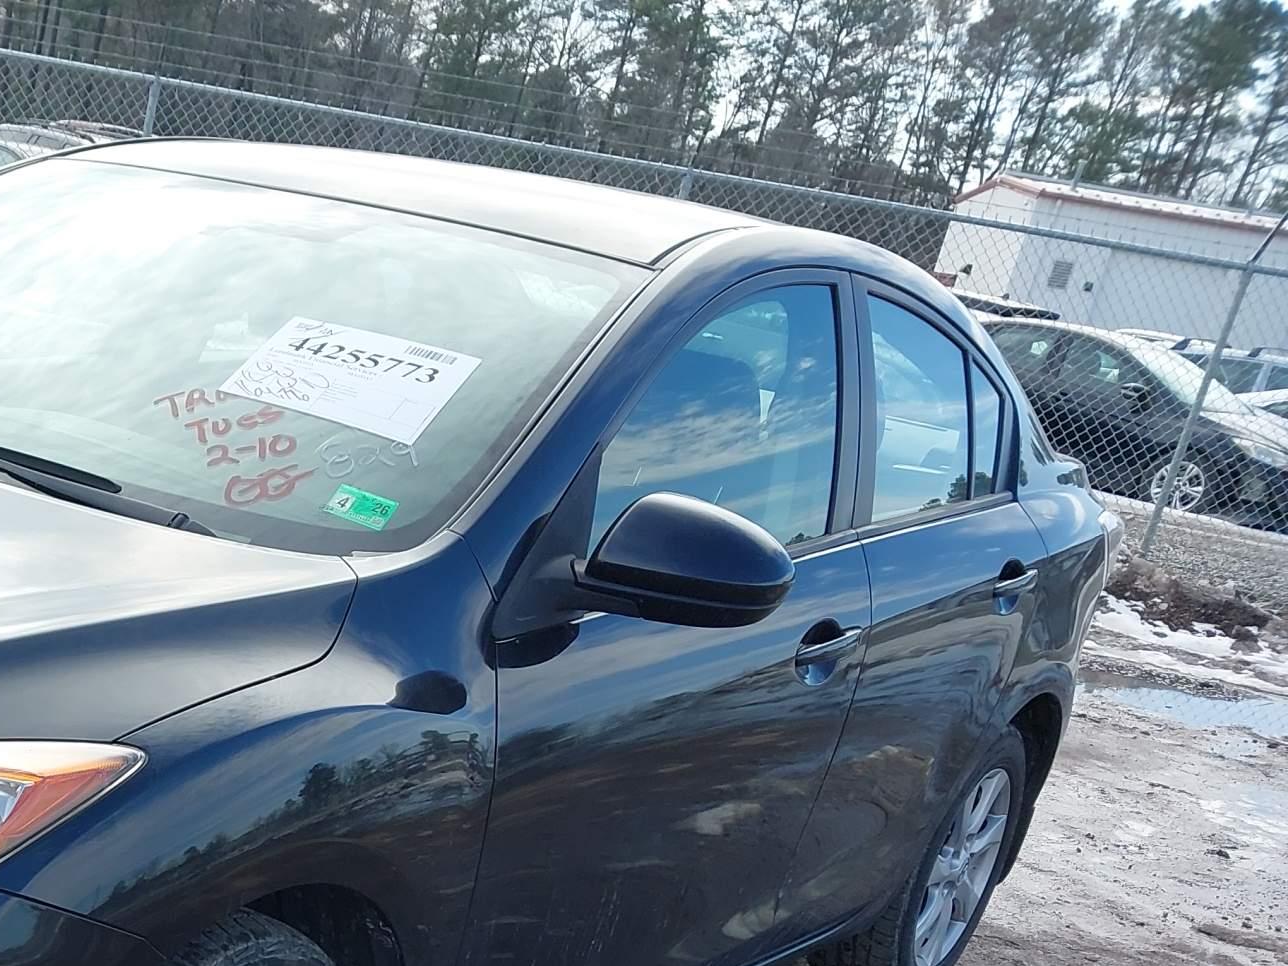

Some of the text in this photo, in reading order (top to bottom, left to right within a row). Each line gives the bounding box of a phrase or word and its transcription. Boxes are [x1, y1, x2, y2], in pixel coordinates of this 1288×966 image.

[288, 336, 441, 384] 44255773
[207, 433, 297, 467] 2-10
[336, 496, 350, 508] 4
[371, 502, 391, 516] 26
